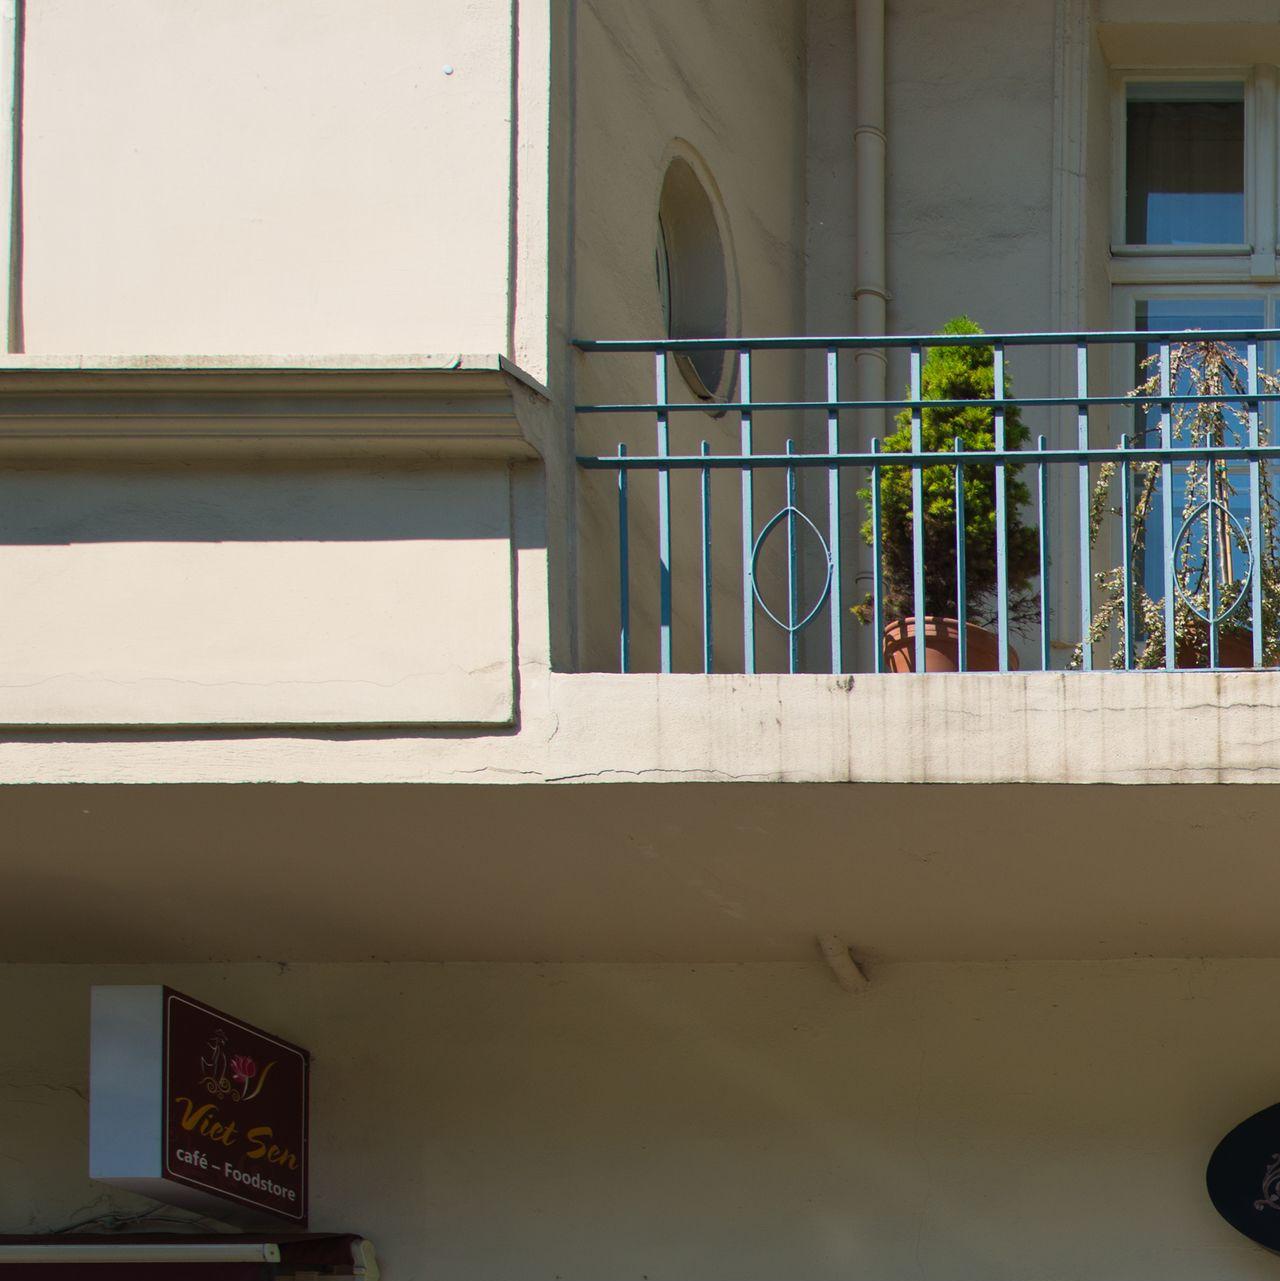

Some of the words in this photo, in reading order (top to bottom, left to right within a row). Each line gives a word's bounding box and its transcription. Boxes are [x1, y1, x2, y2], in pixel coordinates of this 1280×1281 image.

[175, 1097, 239, 1146] Viet
[246, 1126, 299, 1170] Sen
[176, 1148, 208, 1170] café
[224, 1162, 297, 1202] Foodstore
